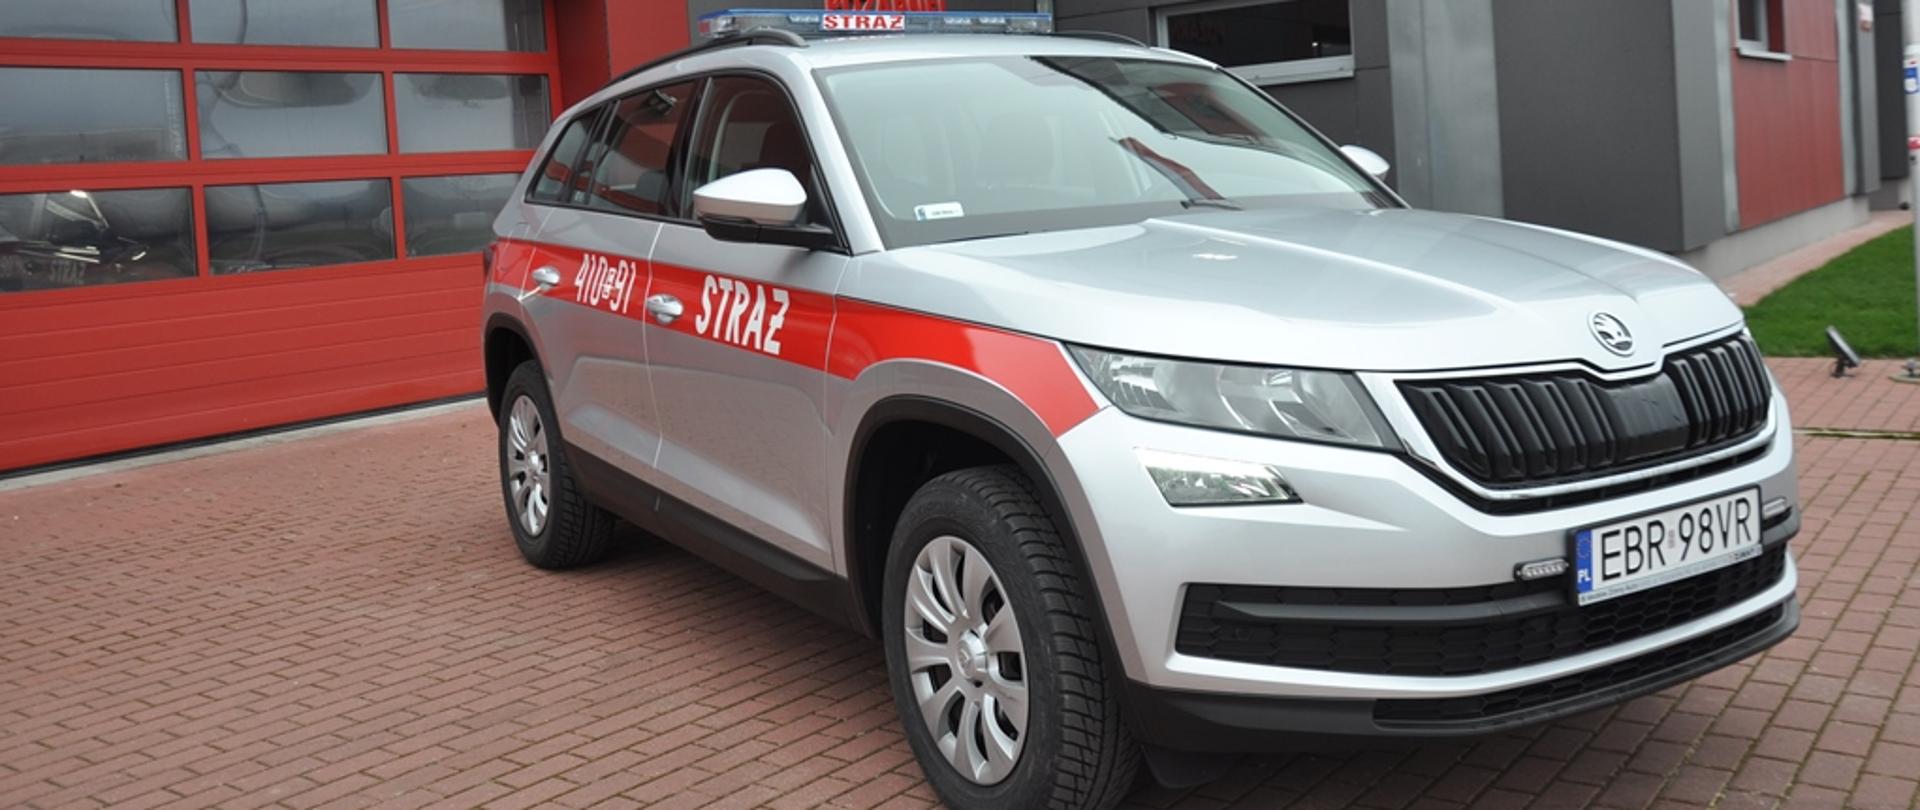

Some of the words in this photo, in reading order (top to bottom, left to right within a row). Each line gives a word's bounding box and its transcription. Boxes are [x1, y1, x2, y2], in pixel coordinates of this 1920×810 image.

[695, 273, 791, 356] STRAŻ
[1577, 569, 1592, 584] PL
[1601, 519, 1667, 582] EBR
[1678, 496, 1752, 562] 98VR
